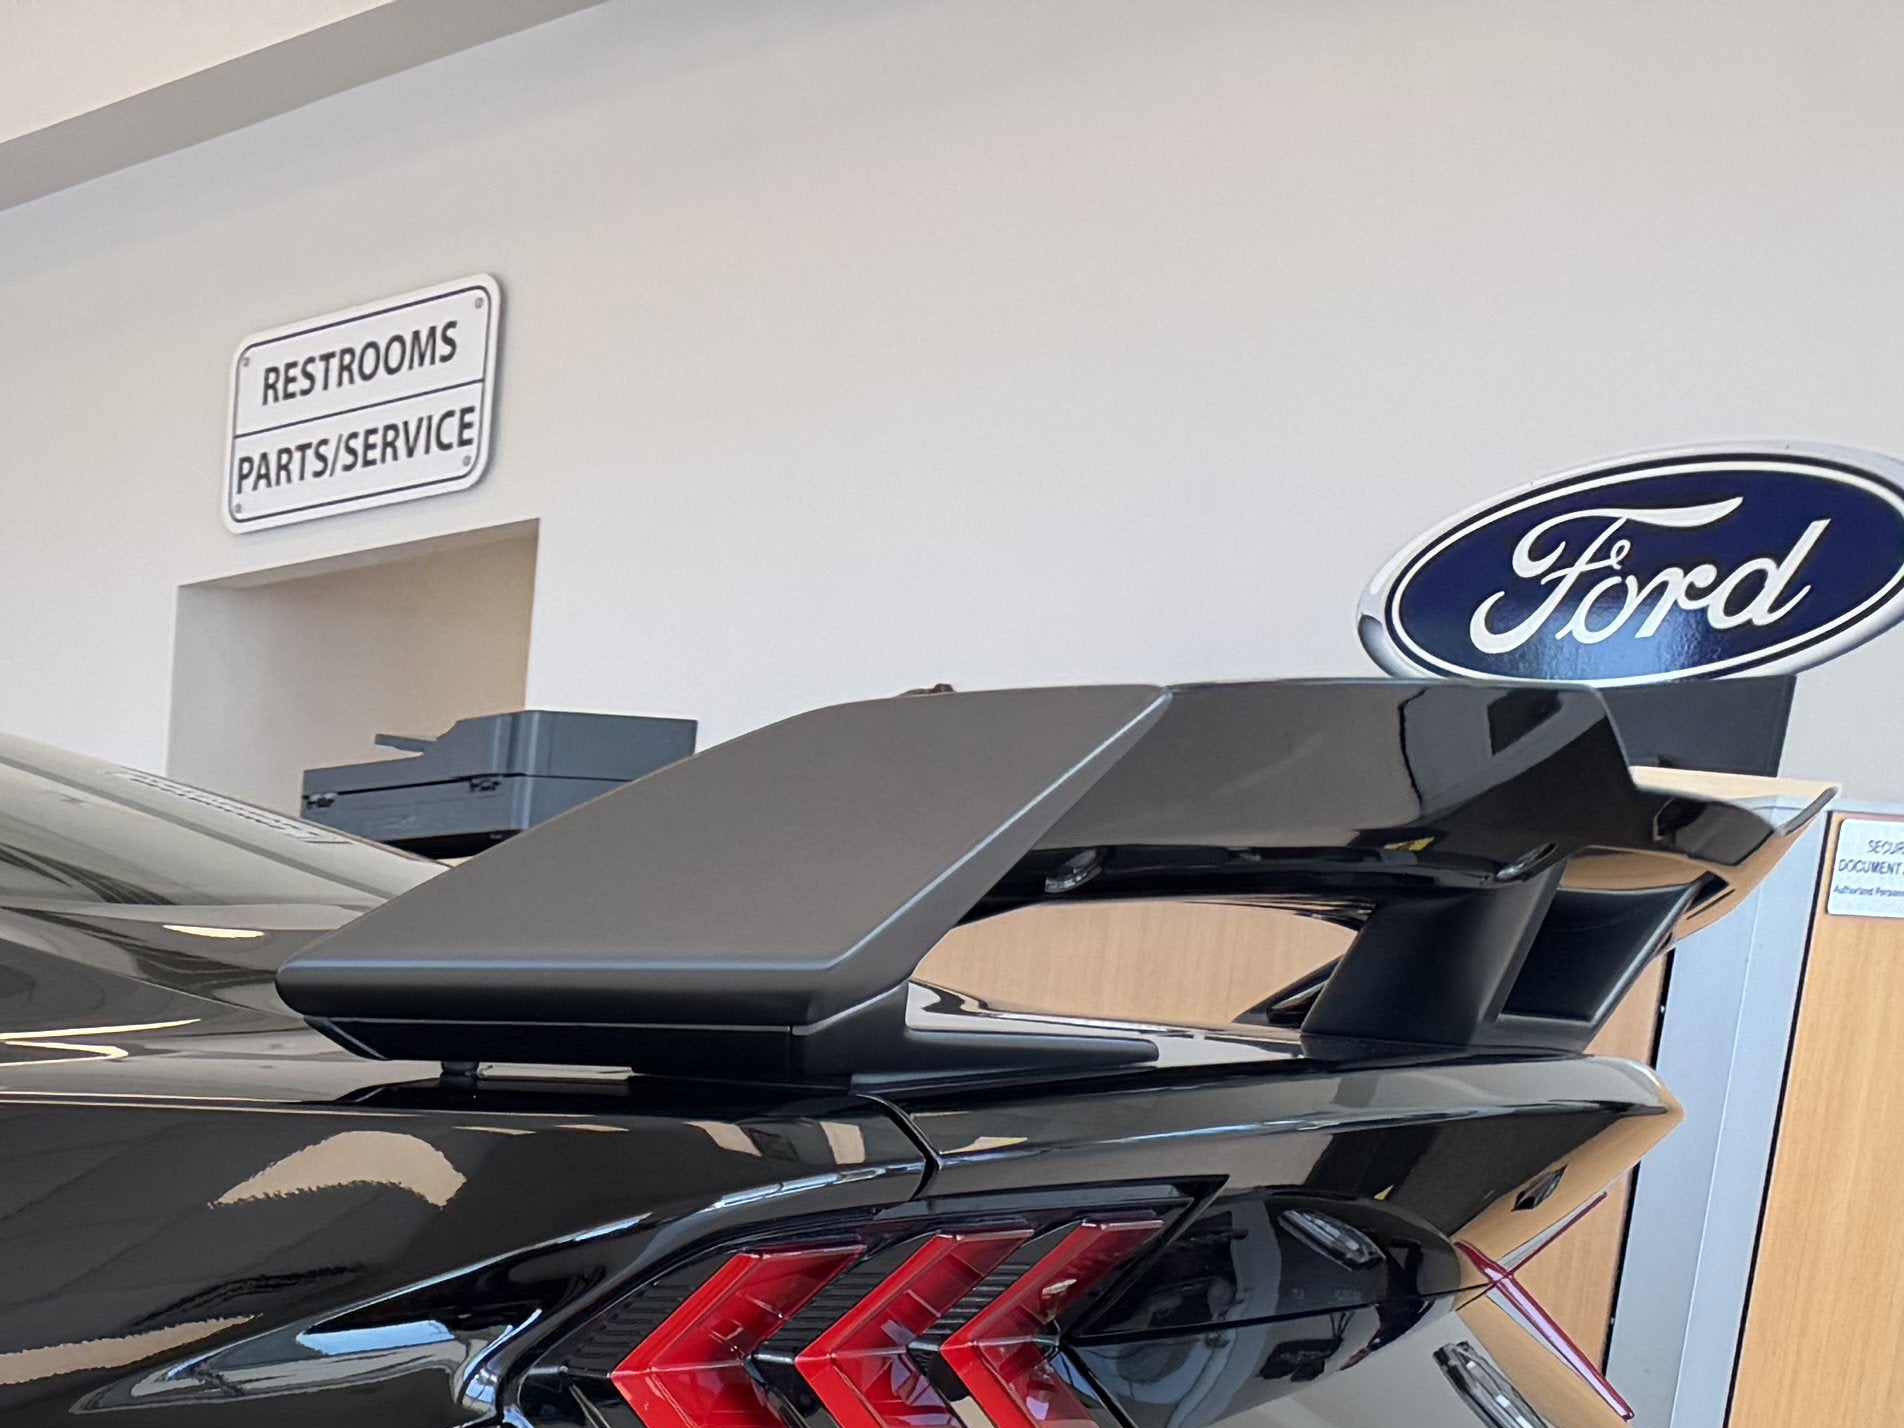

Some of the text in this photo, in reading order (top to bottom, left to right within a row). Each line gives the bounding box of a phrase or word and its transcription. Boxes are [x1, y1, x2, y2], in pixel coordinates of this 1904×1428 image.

[262, 320, 458, 405] RESTROOMS
[237, 405, 476, 495] PARTS/SERVICE
[1469, 497, 1831, 654] Ford
[1838, 858, 1902, 875] DOCUMENT
